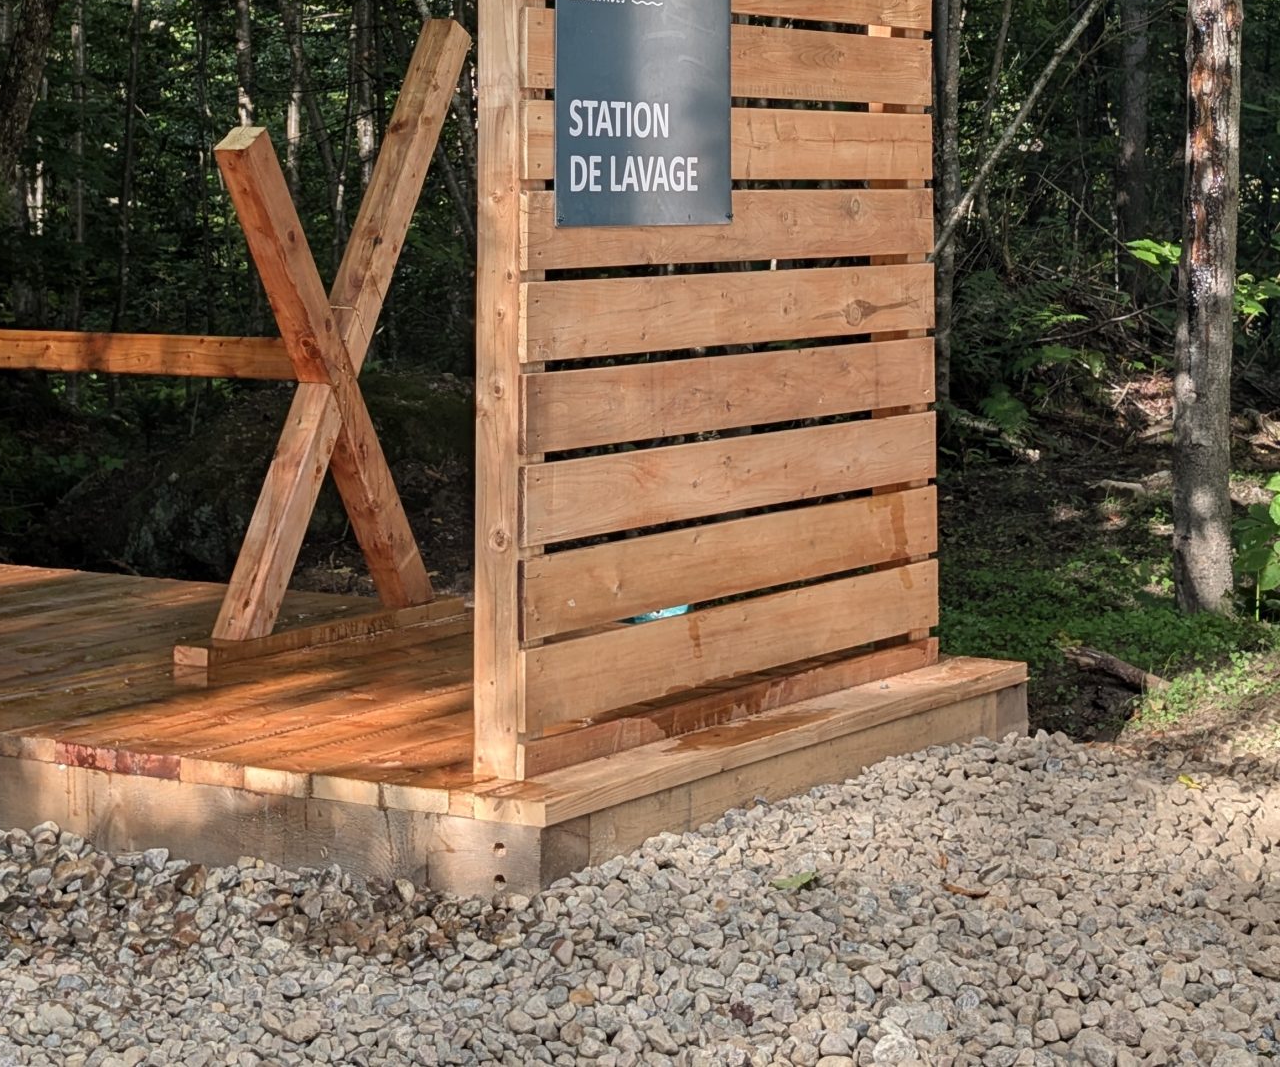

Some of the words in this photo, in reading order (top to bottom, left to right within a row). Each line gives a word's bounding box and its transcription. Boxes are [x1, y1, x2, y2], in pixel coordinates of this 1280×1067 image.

[569, 99, 669, 138] STATION
[570, 155, 602, 192] DE
[610, 155, 699, 192] LAVAGE
